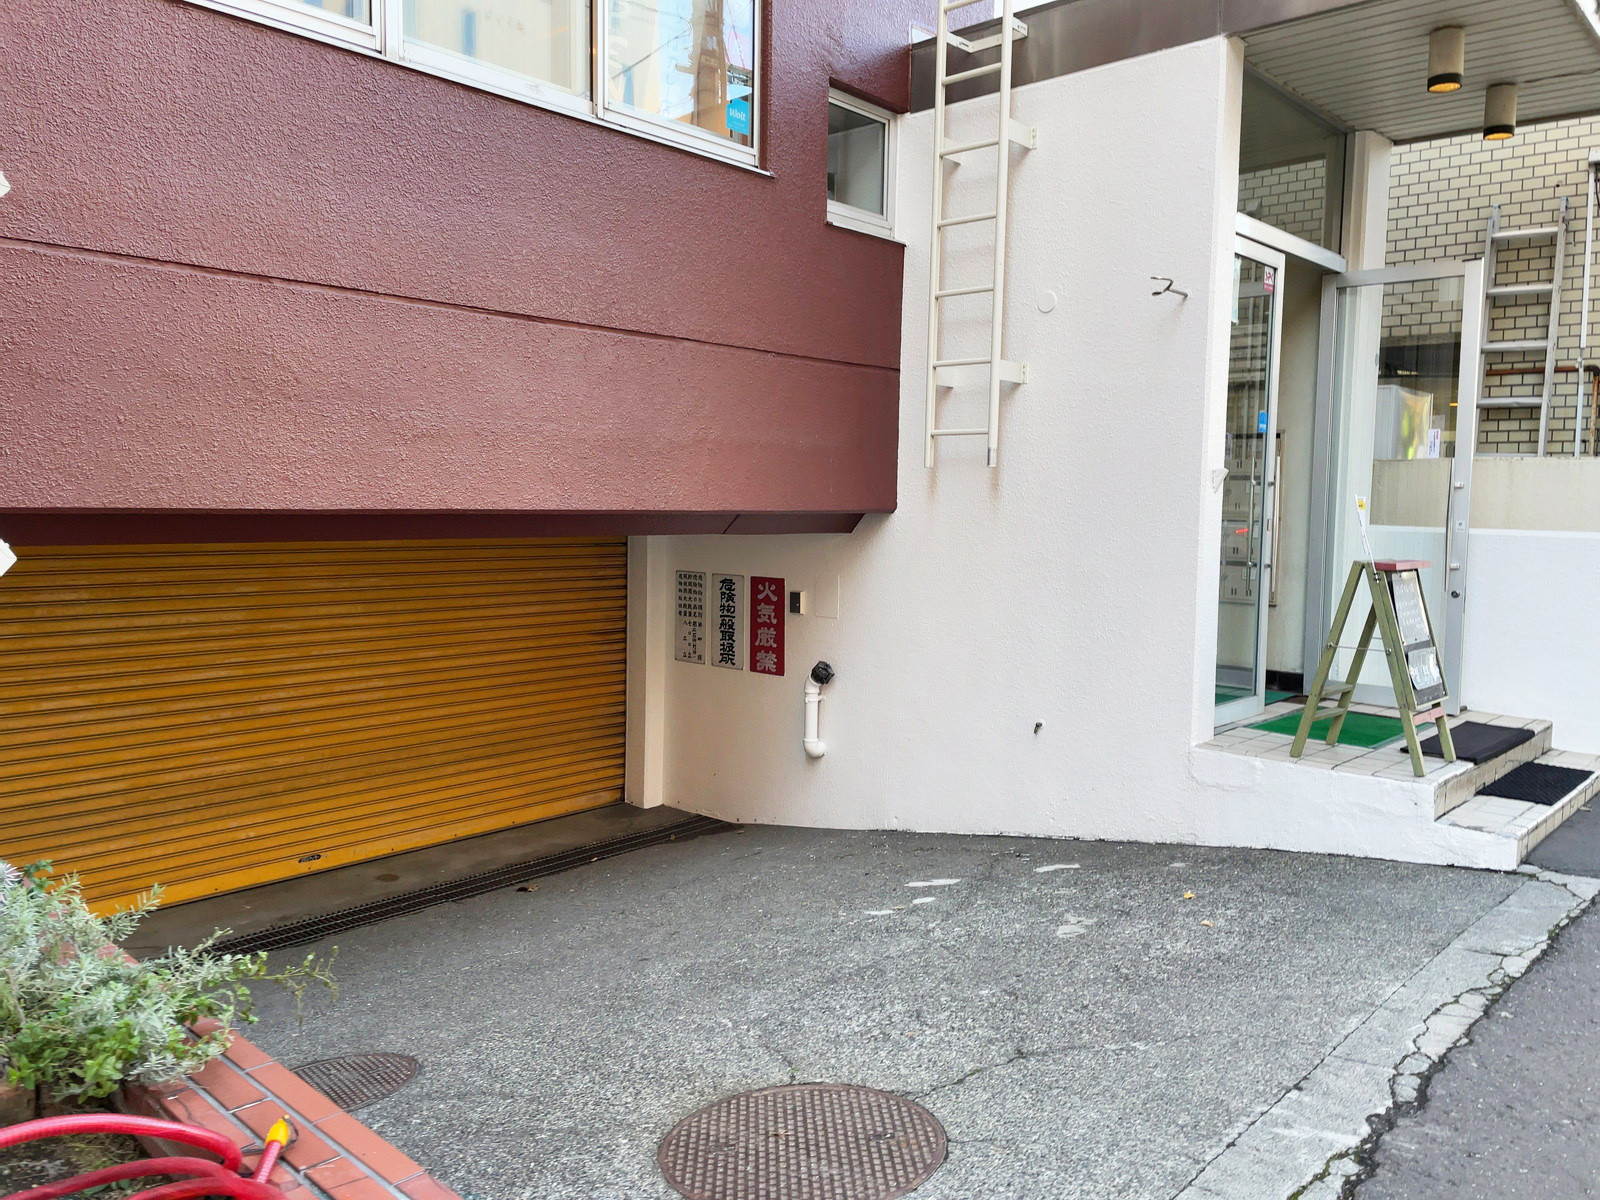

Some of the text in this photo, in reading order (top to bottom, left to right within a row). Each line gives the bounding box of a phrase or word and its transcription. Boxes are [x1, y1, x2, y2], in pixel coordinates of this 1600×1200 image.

[729, 108, 746, 121] Wolt
[719, 577, 736, 666] 危険物一般取扱所
[755, 582, 778, 673] 火気厳禁
